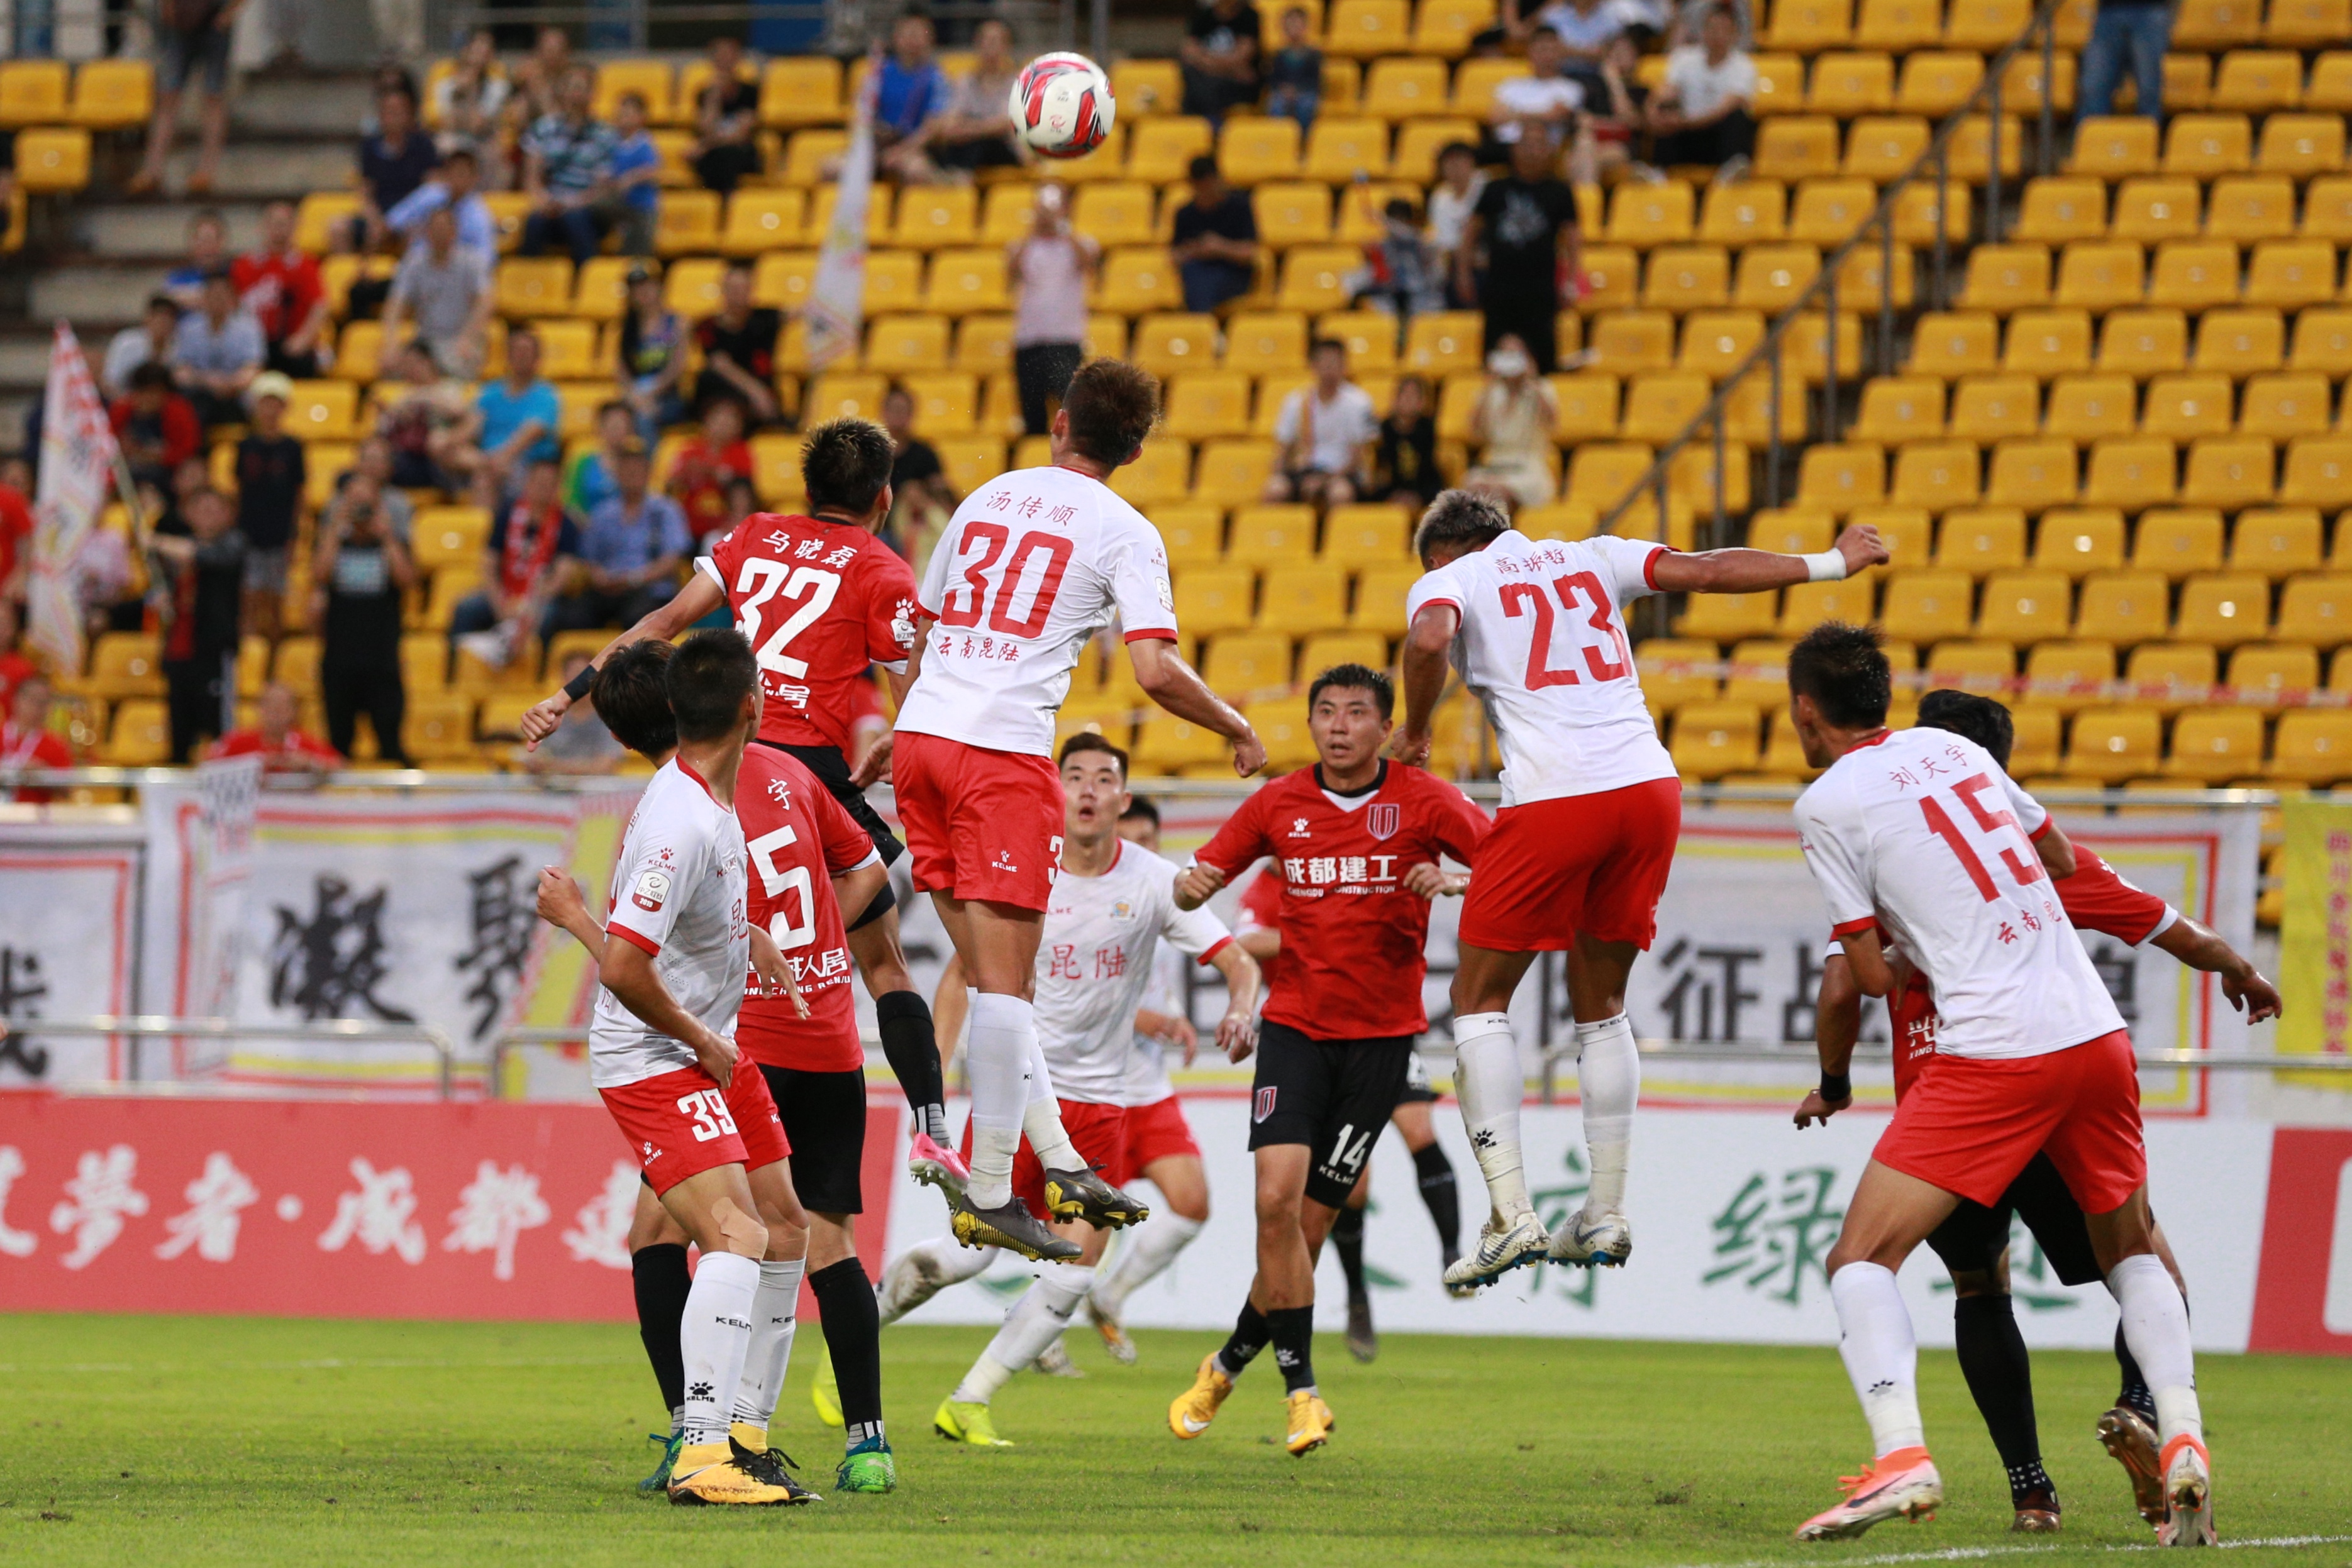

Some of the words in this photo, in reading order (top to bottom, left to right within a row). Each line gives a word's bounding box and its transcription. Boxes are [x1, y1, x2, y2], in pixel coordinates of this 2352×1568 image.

[986, 492, 1079, 527] 汤传顺
[762, 529, 858, 568] 马晓磊
[940, 521, 1075, 639] 30
[735, 557, 841, 680] 32
[1499, 571, 1633, 692] 23
[938, 635, 1020, 662] 云南昆陆
[1889, 744, 1966, 792] 刘天宇
[767, 778, 791, 810] 宇
[1919, 772, 2046, 903] 15
[648, 859, 677, 873] KELME
[992, 861, 1018, 873] KELME
[1284, 855, 1397, 885] 成都建工
[746, 824, 816, 951] 5
[1050, 945, 1128, 980] 昆陆
[677, 1088, 739, 1142] 39
[645, 1149, 663, 1167] KELME
[1328, 1123, 1372, 1174] 14
[686, 1395, 716, 1403] KELME
